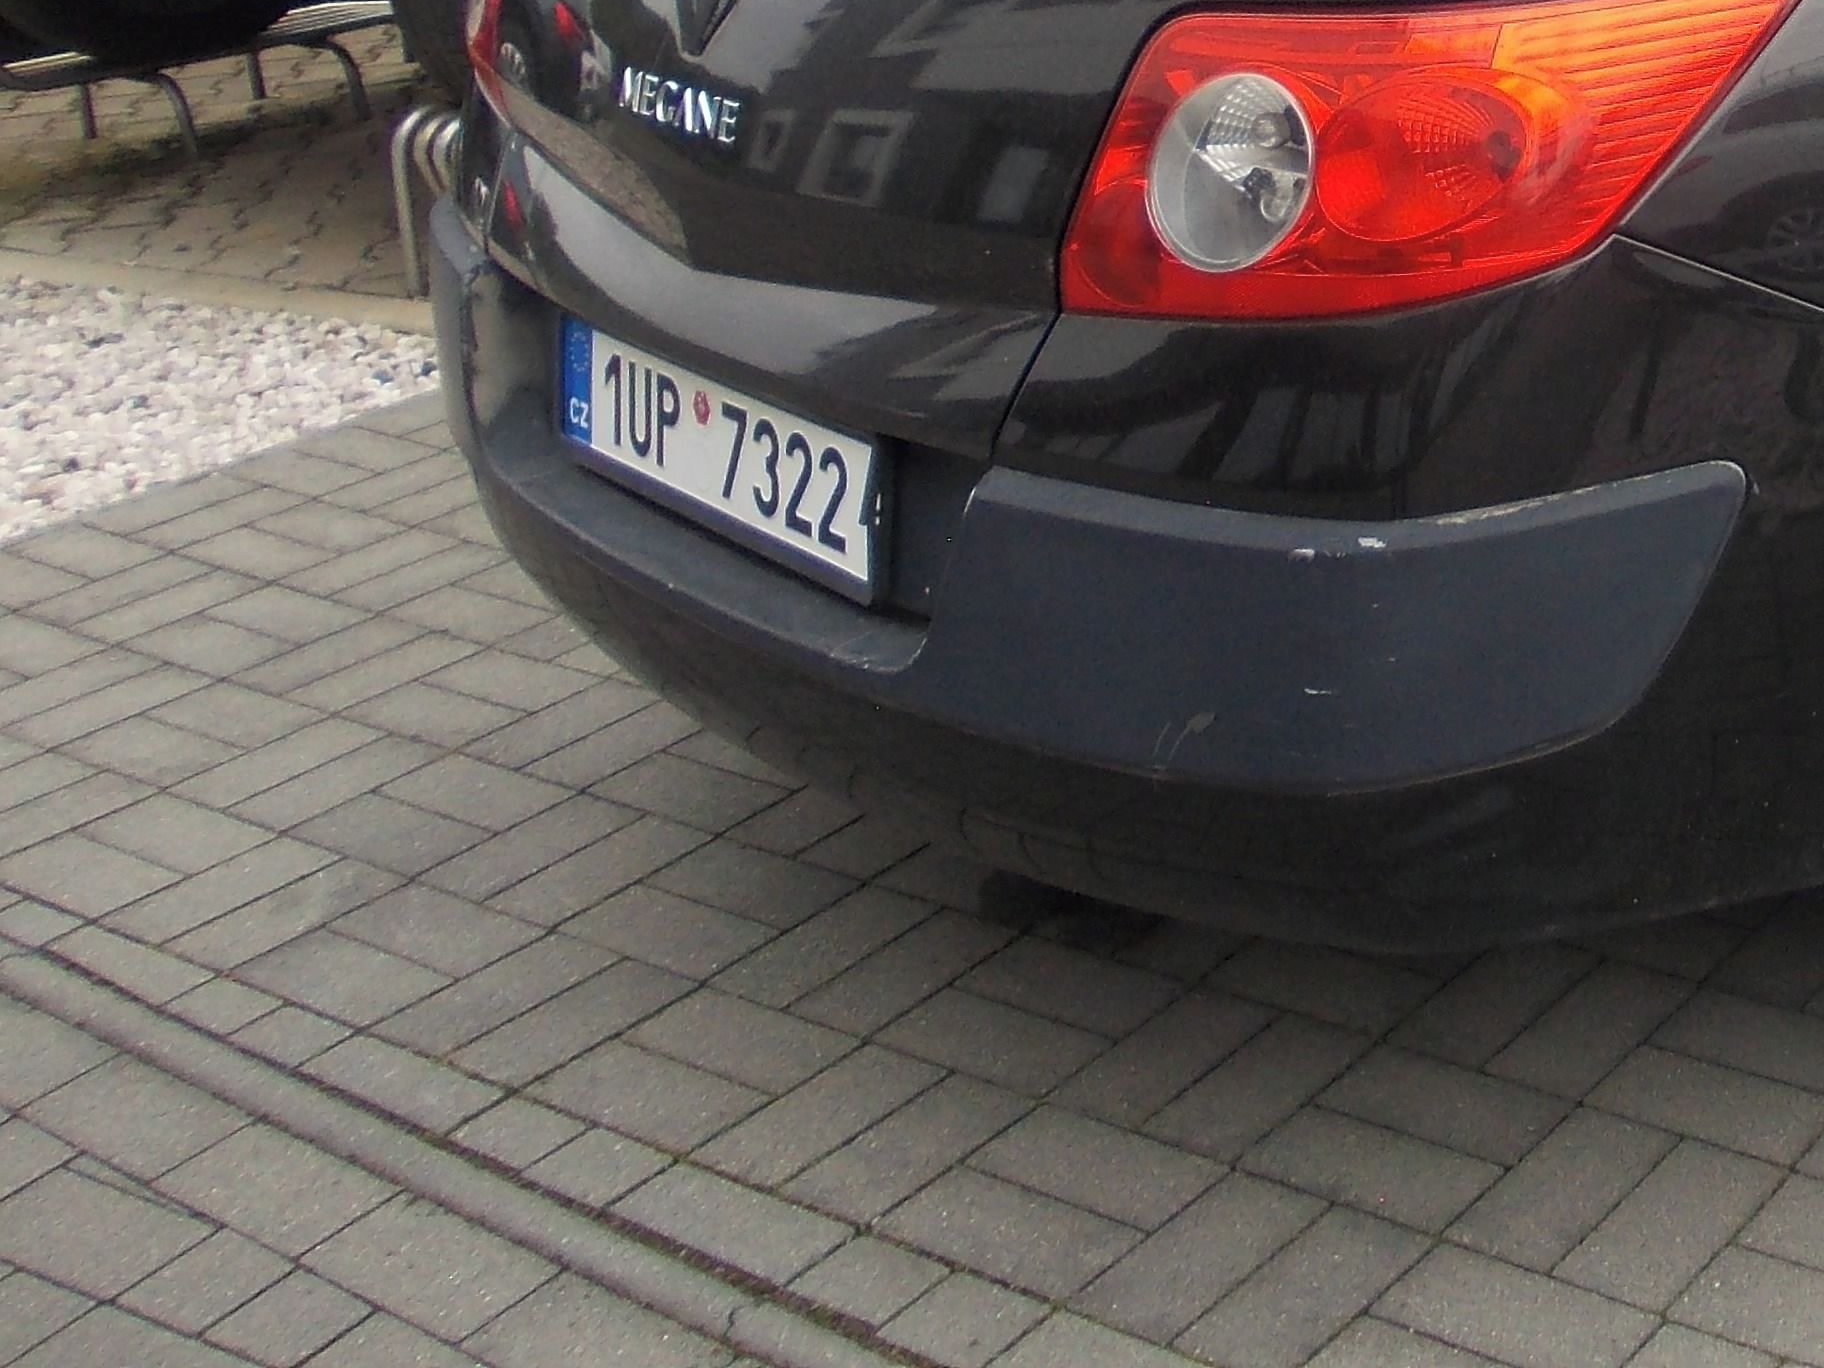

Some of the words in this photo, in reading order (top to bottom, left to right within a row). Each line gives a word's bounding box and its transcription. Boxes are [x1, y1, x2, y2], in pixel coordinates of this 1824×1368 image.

[619, 65, 740, 144] MEGANE
[569, 396, 589, 429] CZ
[605, 352, 682, 467] 1UP
[721, 400, 849, 554] 7322
